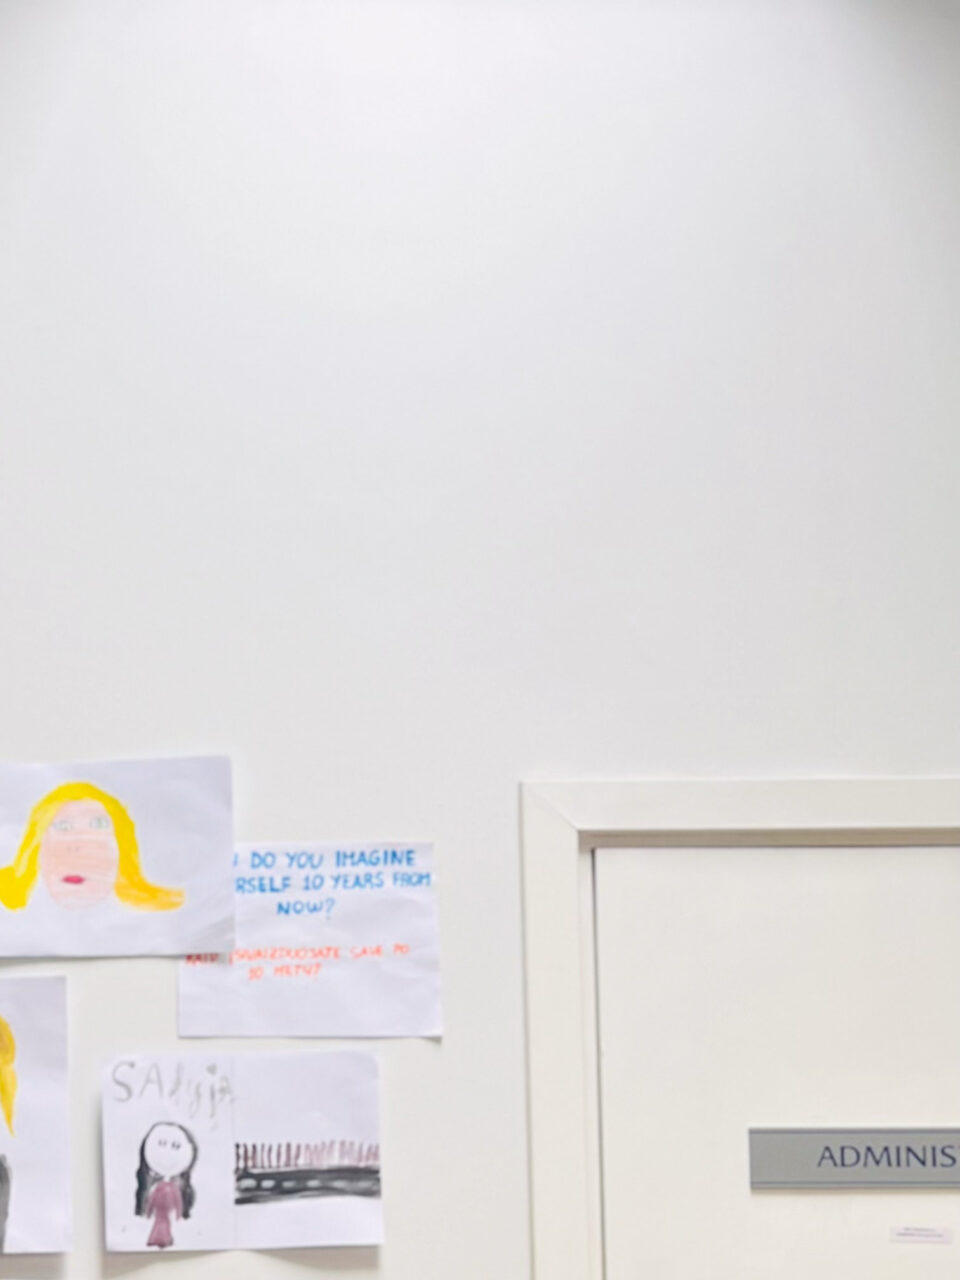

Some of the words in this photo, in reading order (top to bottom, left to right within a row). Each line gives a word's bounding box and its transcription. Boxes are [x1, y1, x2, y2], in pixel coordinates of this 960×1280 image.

[250, 851, 277, 869] DO
[286, 851, 324, 869] YOU
[336, 849, 416, 868] IMAGINE
[303, 874, 325, 891] 10
[331, 872, 384, 890] YEARS
[392, 871, 433, 887] FROM
[276, 897, 336, 921] NOW?
[817, 1144, 960, 1169] ADMINIS
